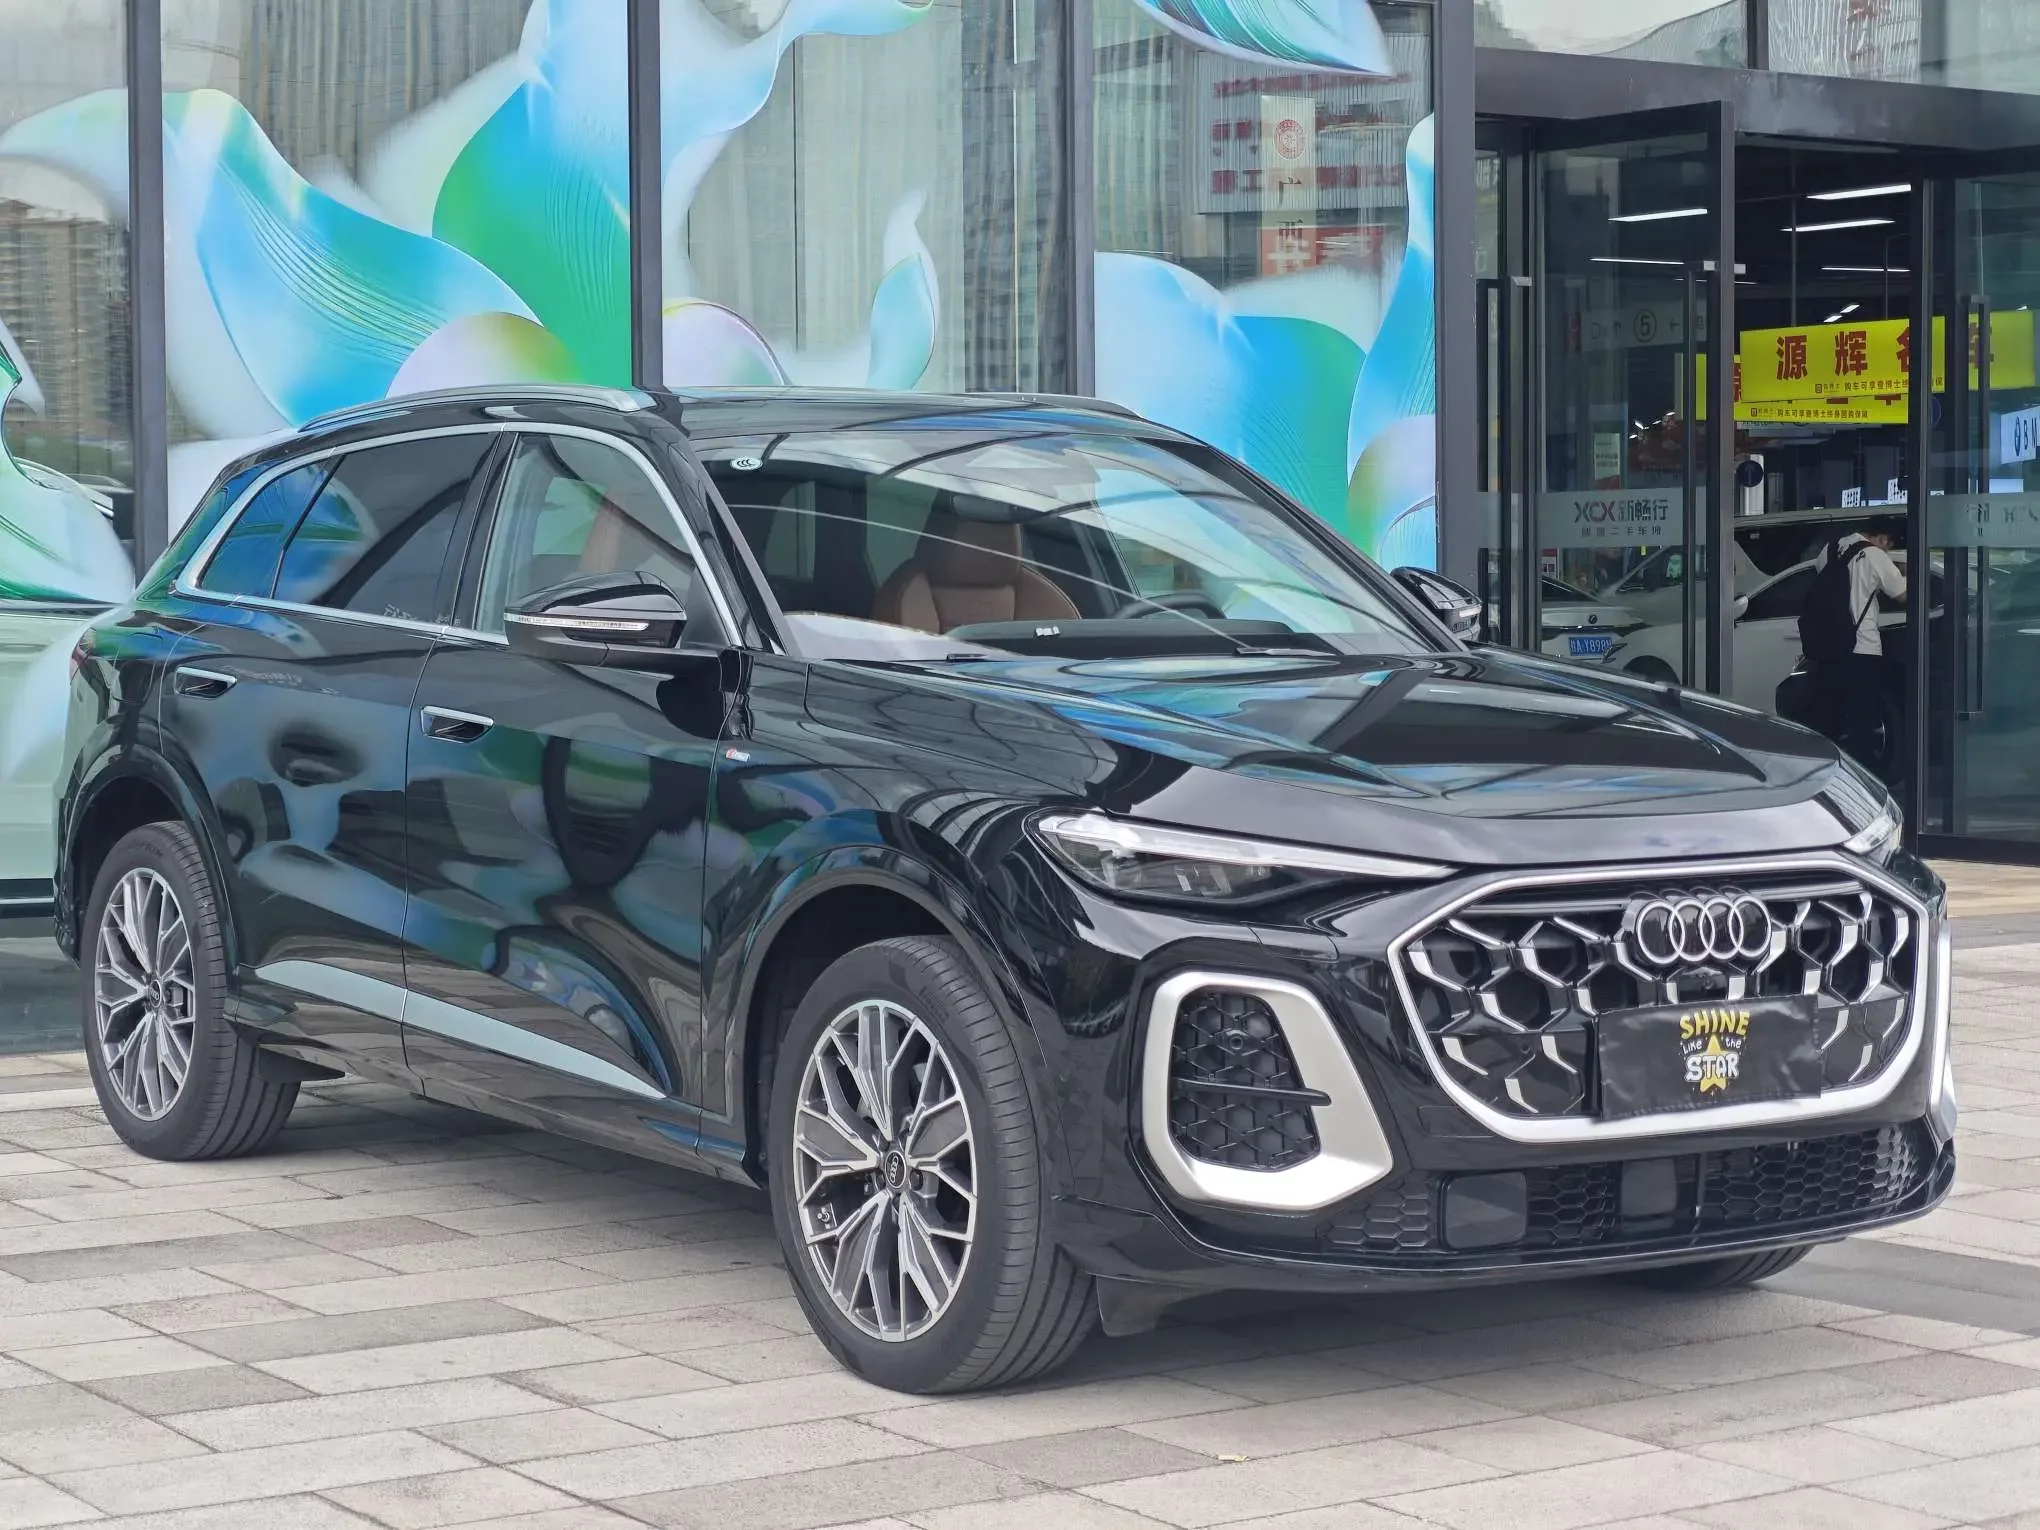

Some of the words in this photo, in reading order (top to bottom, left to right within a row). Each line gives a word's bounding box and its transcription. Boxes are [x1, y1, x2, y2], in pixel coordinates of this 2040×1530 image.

[1680, 1008, 1751, 1040] SHINE
[1725, 1037, 1742, 1049] the
[1684, 1053, 1740, 1082] STAR
